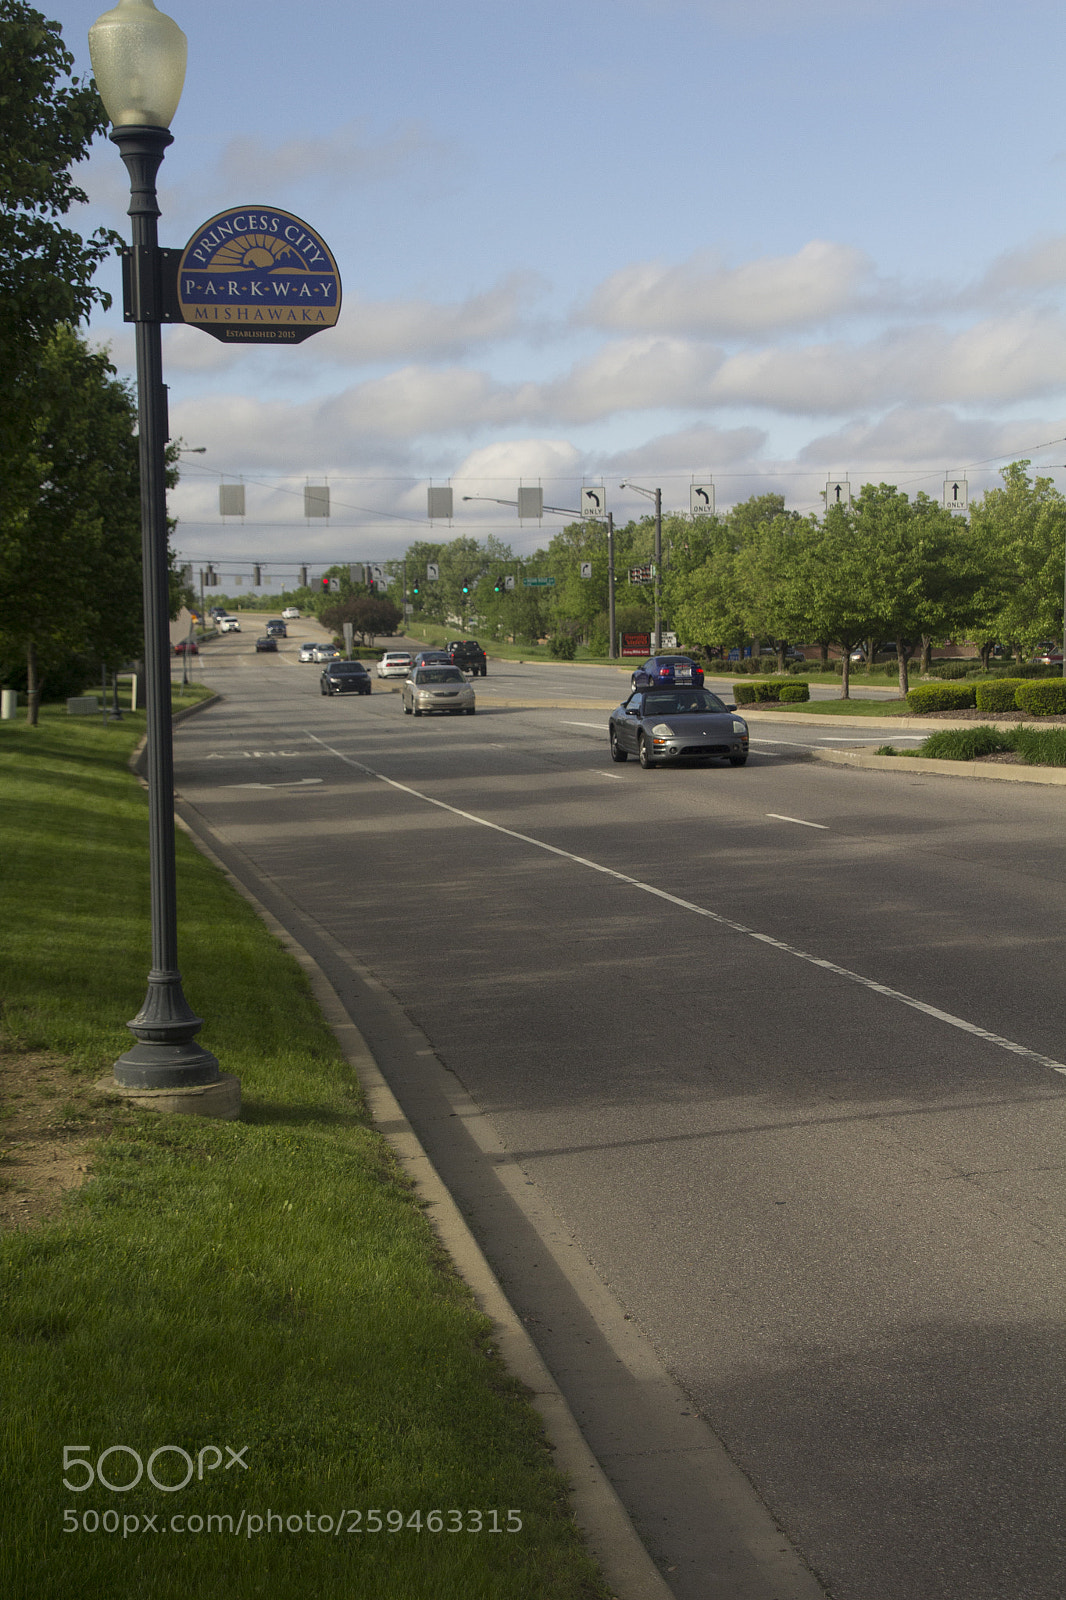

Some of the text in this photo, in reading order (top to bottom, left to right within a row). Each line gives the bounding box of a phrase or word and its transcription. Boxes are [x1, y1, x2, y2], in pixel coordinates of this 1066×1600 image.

[192, 215, 326, 264] PRINCESS CITY
[194, 307, 326, 321] MISHAWAKA
[226, 329, 296, 338] ESTABLISHED 2015
